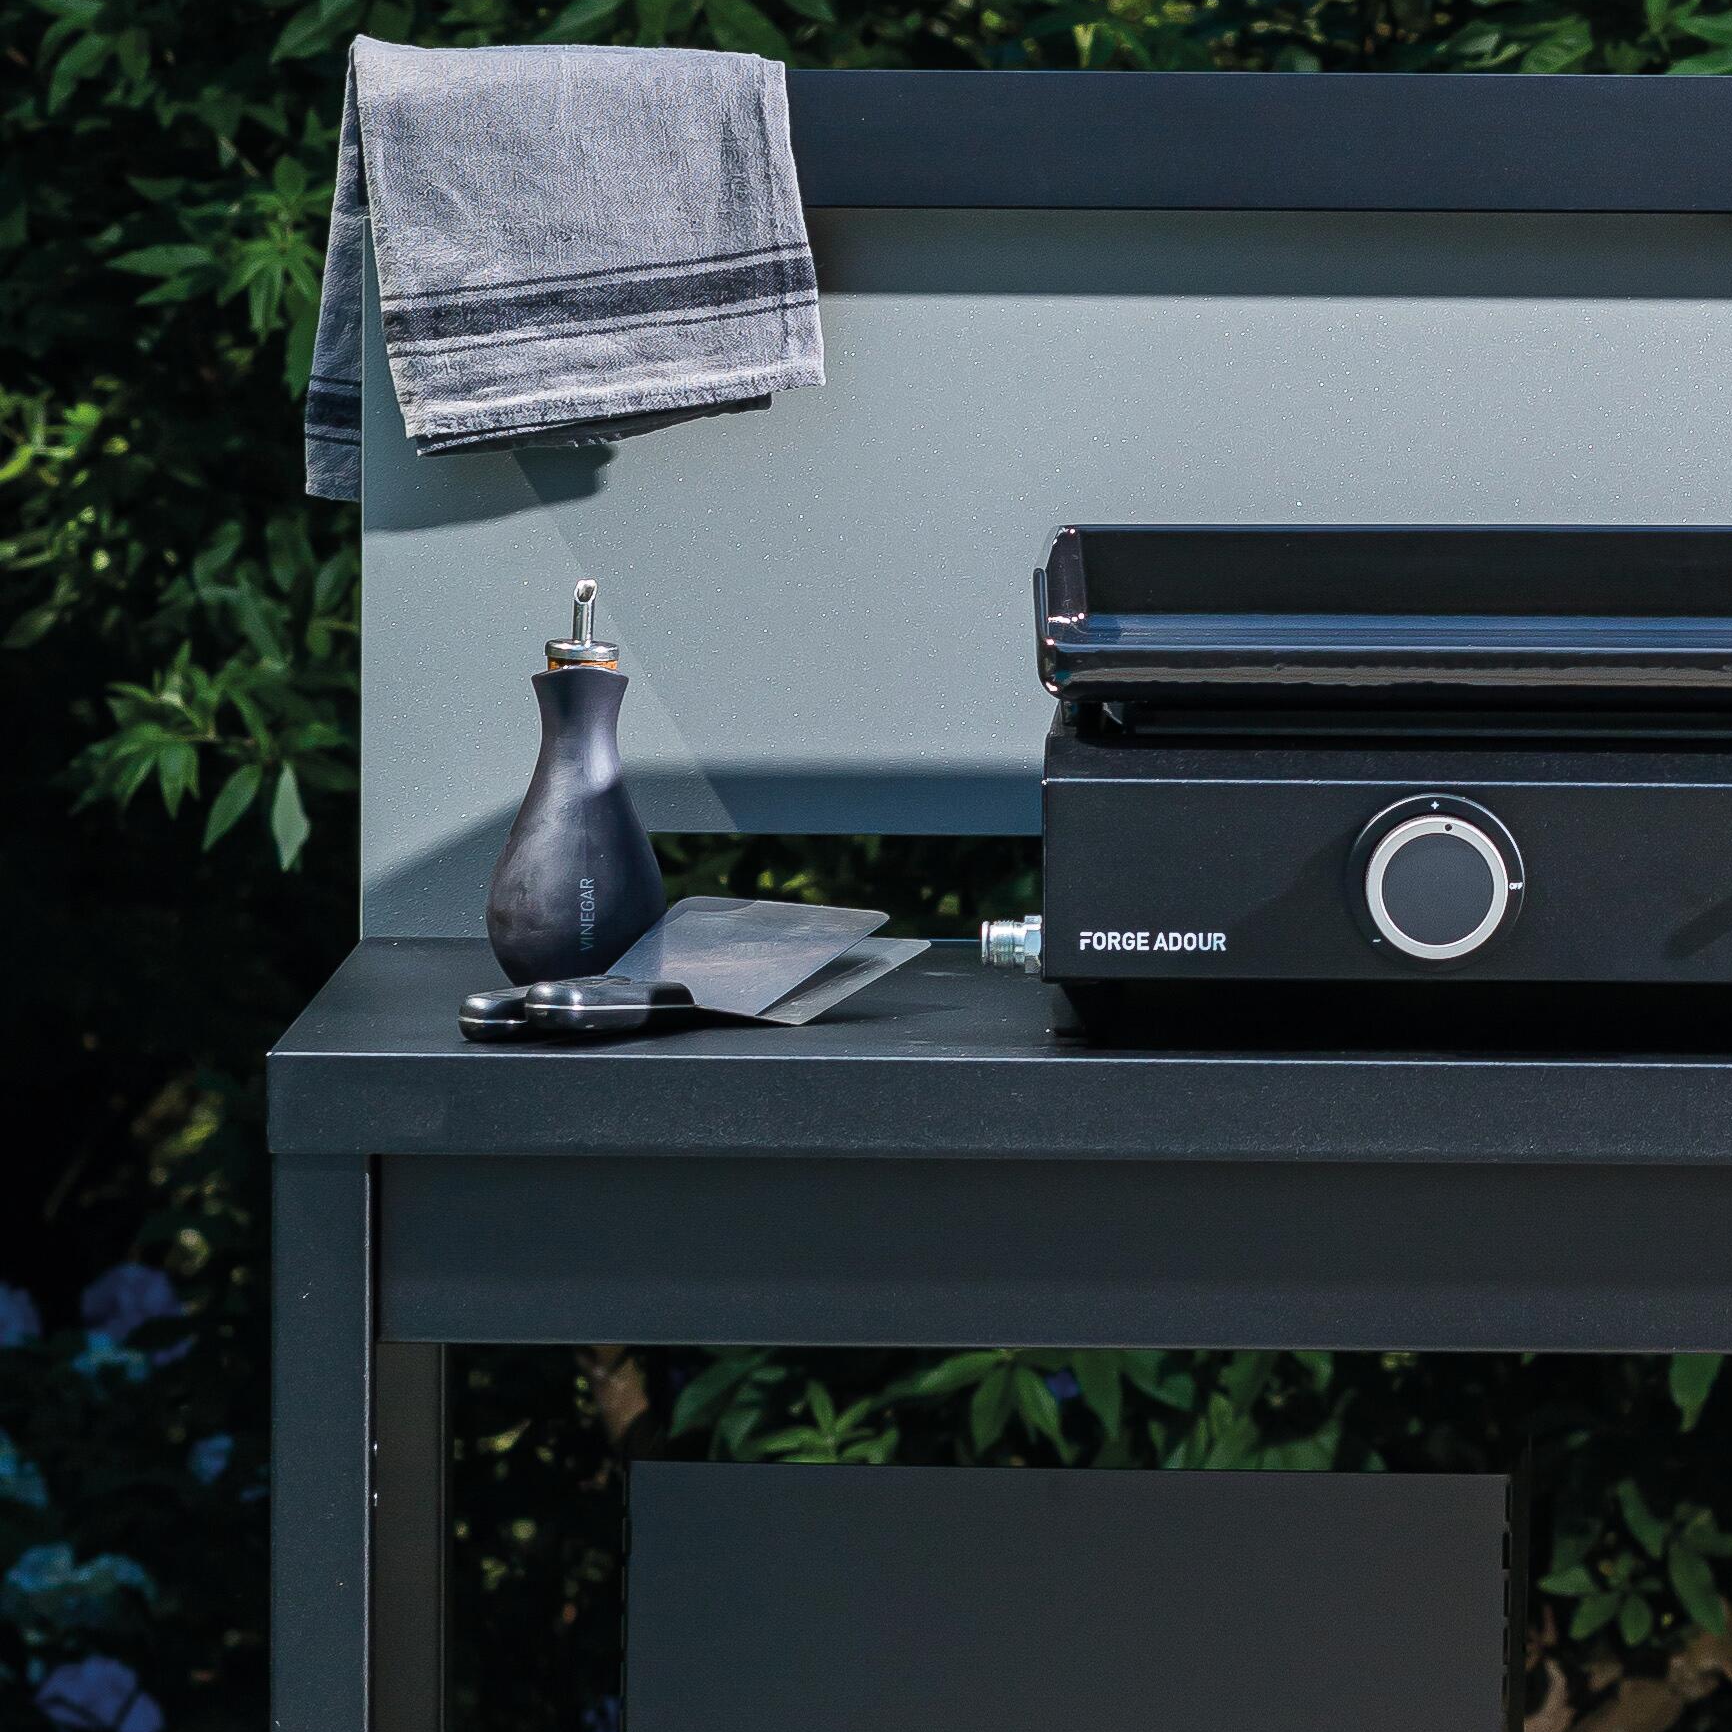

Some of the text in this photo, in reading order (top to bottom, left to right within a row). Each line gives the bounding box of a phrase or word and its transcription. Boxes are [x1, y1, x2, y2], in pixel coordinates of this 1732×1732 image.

[1509, 882, 1523, 890] OFF
[580, 878, 595, 951] VINEGAR
[1079, 931, 1227, 951] FORGE ADOUR
